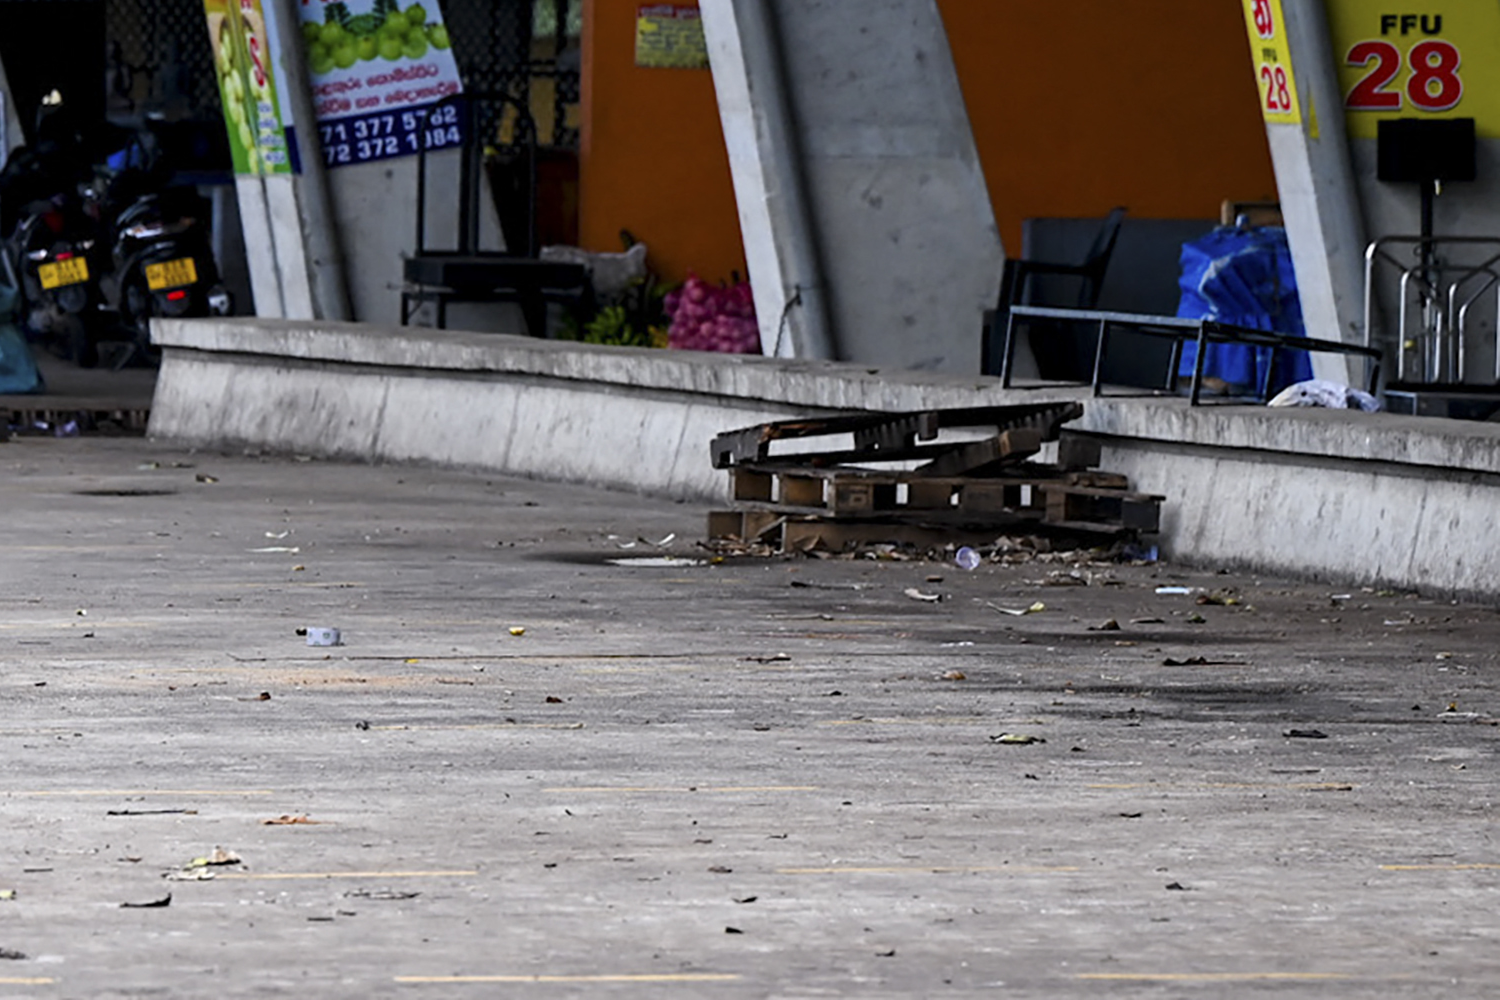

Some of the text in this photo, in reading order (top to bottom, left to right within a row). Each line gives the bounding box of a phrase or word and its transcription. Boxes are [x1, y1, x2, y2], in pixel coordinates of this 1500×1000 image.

[1381, 15, 1442, 35] FFU
[1345, 38, 1463, 110] 28
[1260, 62, 1292, 115] 28
[354, 115, 394, 138] 377
[357, 136, 399, 159] 372
